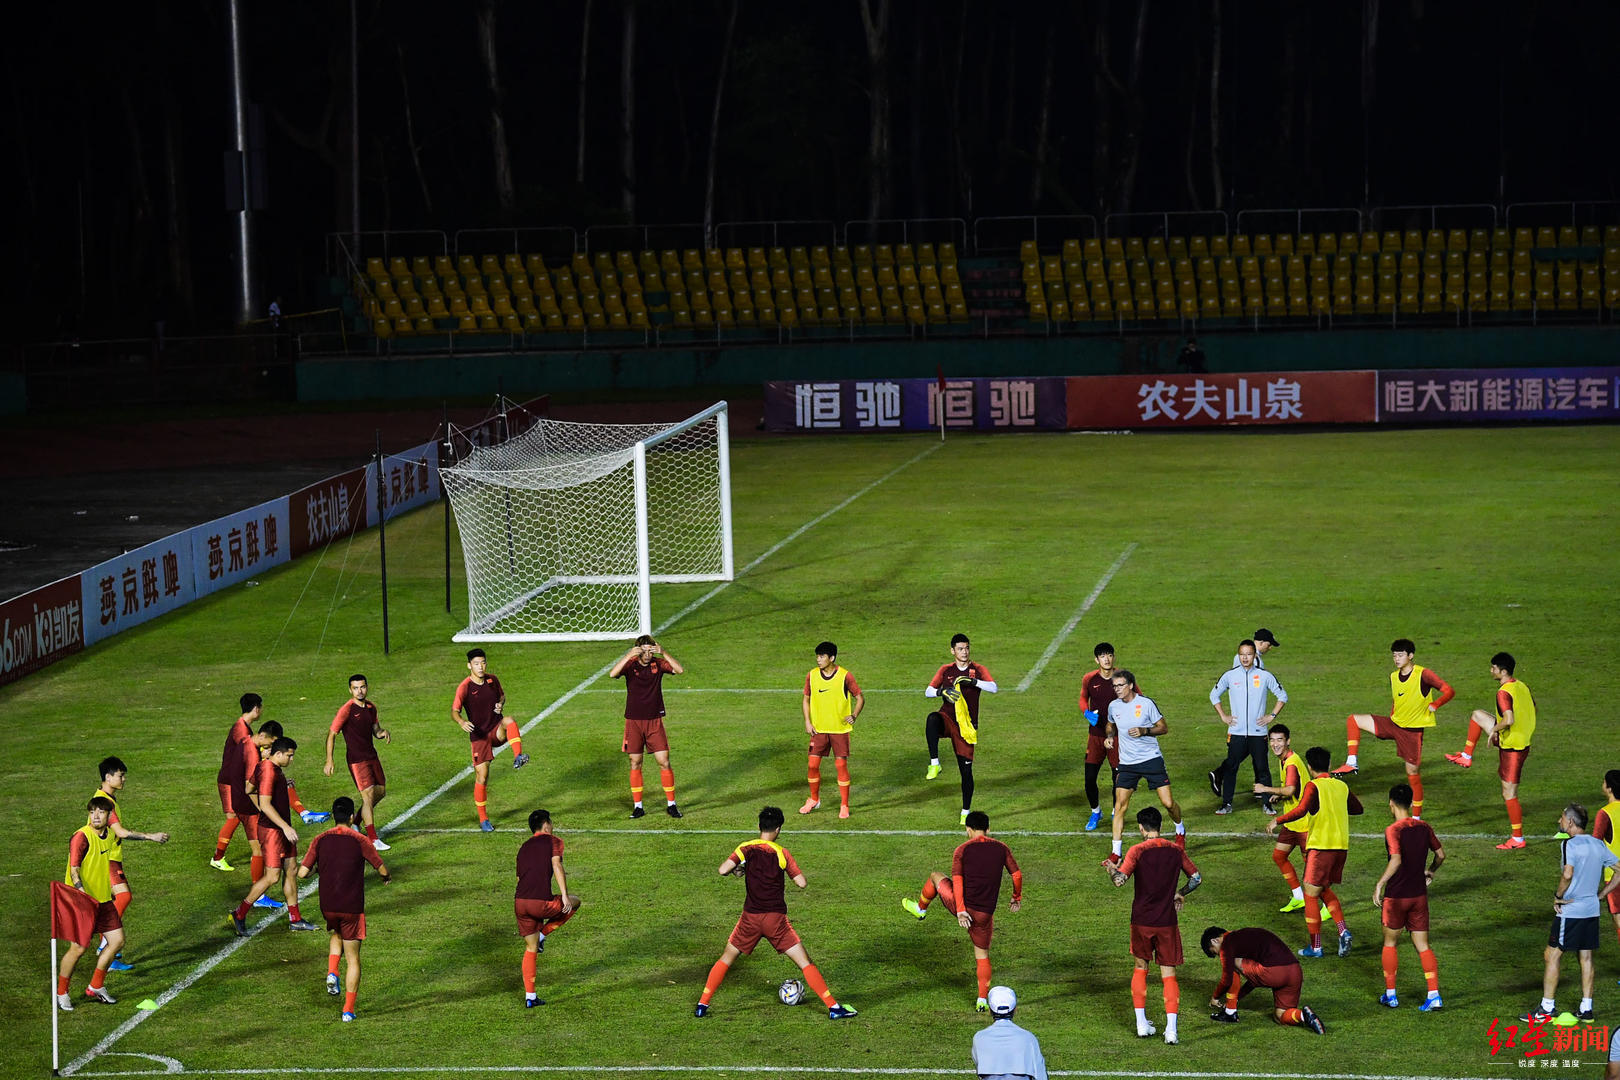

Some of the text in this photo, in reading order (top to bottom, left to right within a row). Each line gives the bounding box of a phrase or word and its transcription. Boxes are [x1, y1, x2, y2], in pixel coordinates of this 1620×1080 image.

[796, 381, 1035, 428] 恒驰 恒驰
[1137, 379, 1303, 421] 农夫山泉
[1384, 377, 1608, 413] 恒大新能源汽车
[306, 482, 350, 546] 农夫山泉
[208, 513, 278, 580] 燕京鲜啤
[99, 550, 181, 626] 燕京鲜啤
